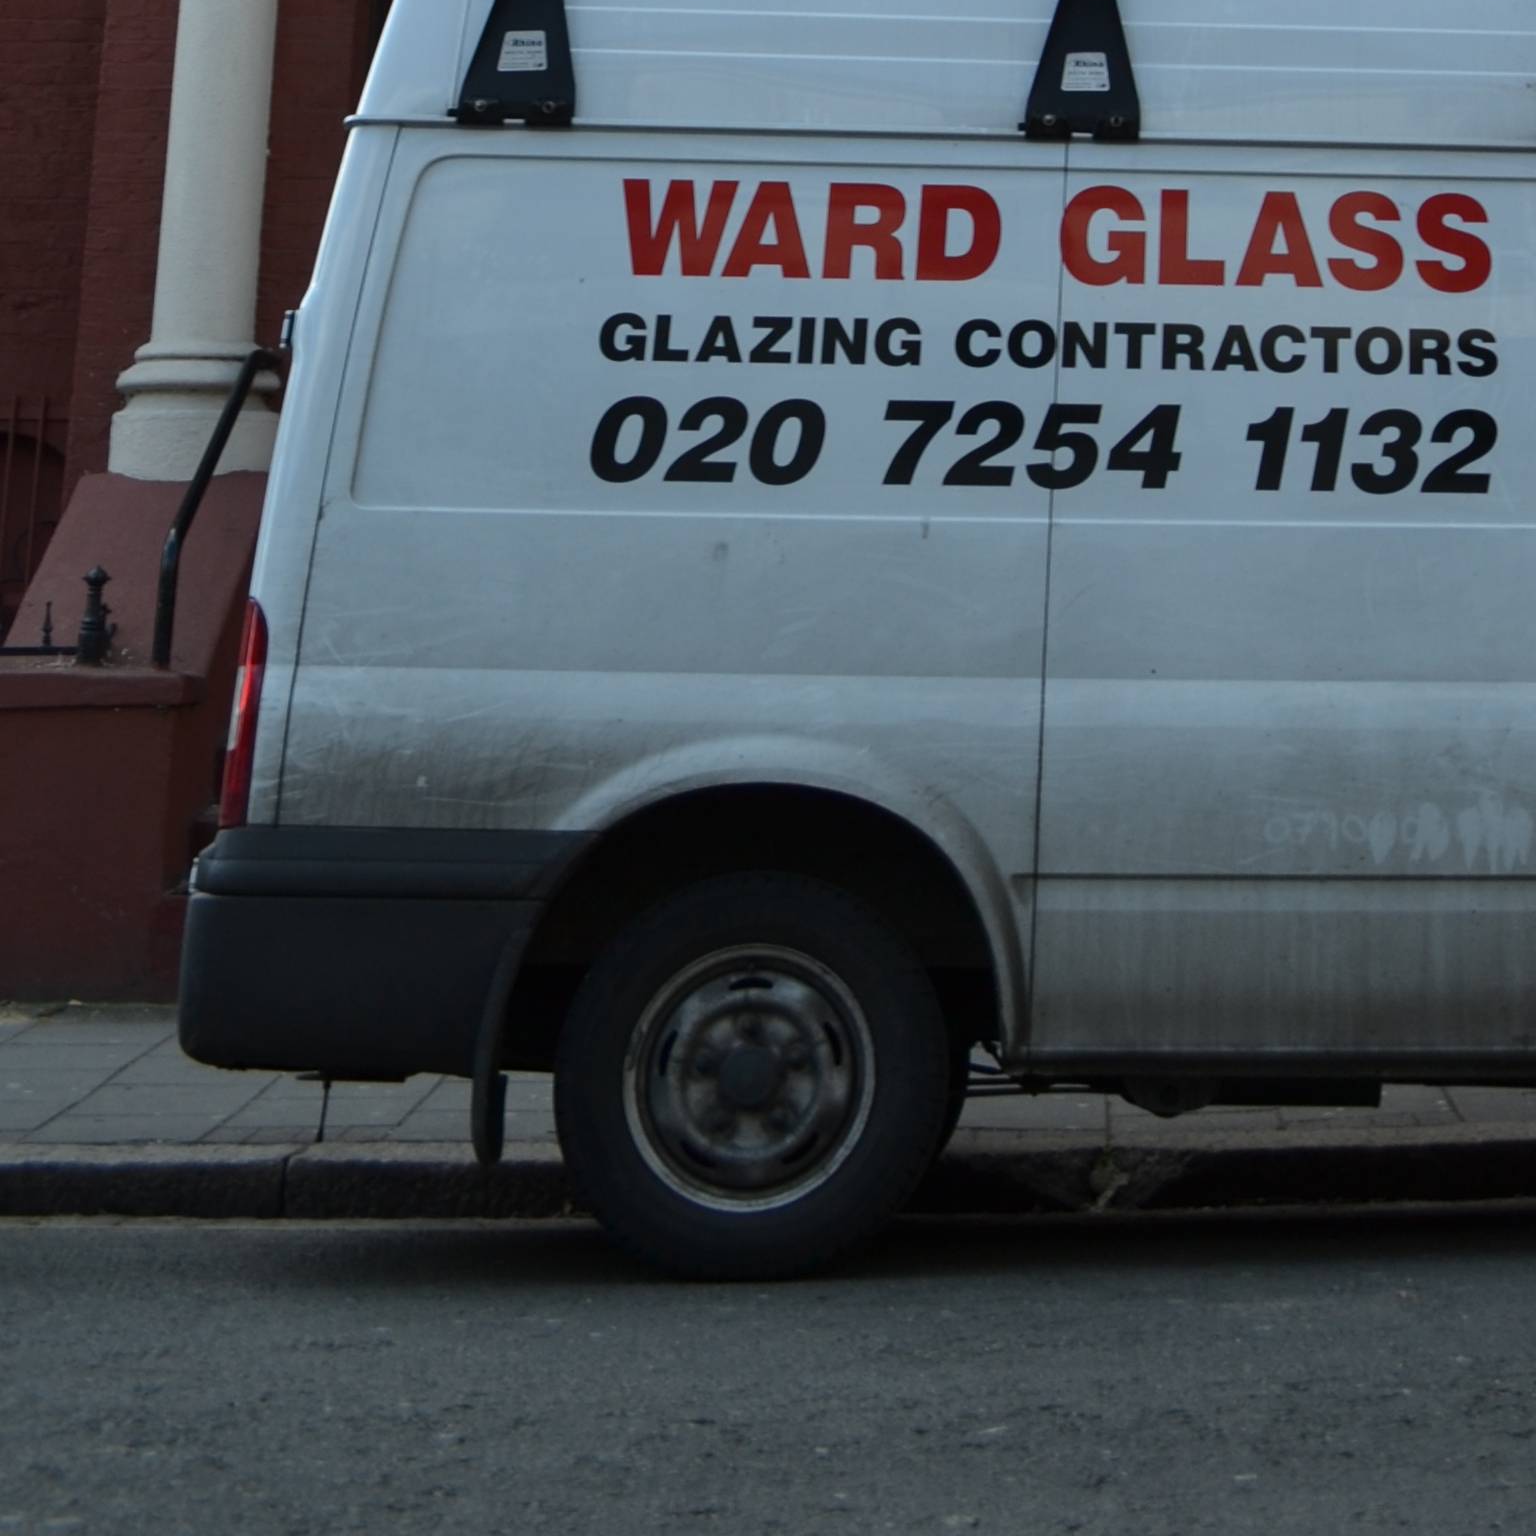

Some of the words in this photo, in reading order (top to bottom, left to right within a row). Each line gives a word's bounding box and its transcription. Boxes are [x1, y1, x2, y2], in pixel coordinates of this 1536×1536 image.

[621, 177, 1002, 282] WARD
[1058, 185, 1493, 294] GLASS
[598, 312, 924, 367] GLAZING
[954, 318, 1500, 378] CONTRACTORS
[588, 395, 827, 486] 020
[880, 399, 1183, 490] 7254
[1245, 405, 1500, 495] 1132
